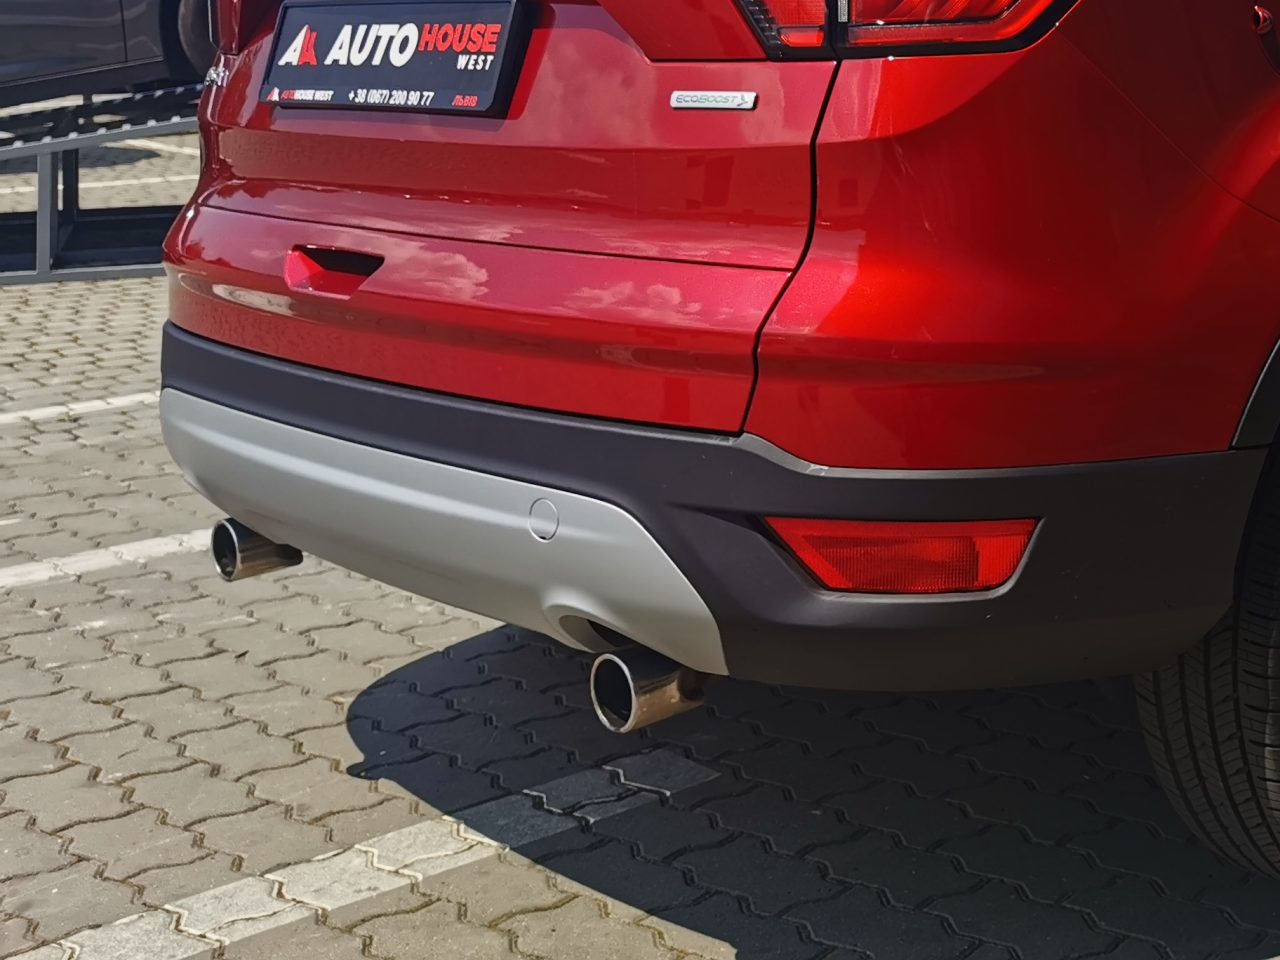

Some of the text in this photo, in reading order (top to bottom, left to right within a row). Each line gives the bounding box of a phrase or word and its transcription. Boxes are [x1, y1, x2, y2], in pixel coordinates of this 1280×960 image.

[456, 54, 494, 71] WEST
[389, 90, 408, 105] 200
[407, 91, 421, 106] 90
[420, 91, 435, 106] 77
